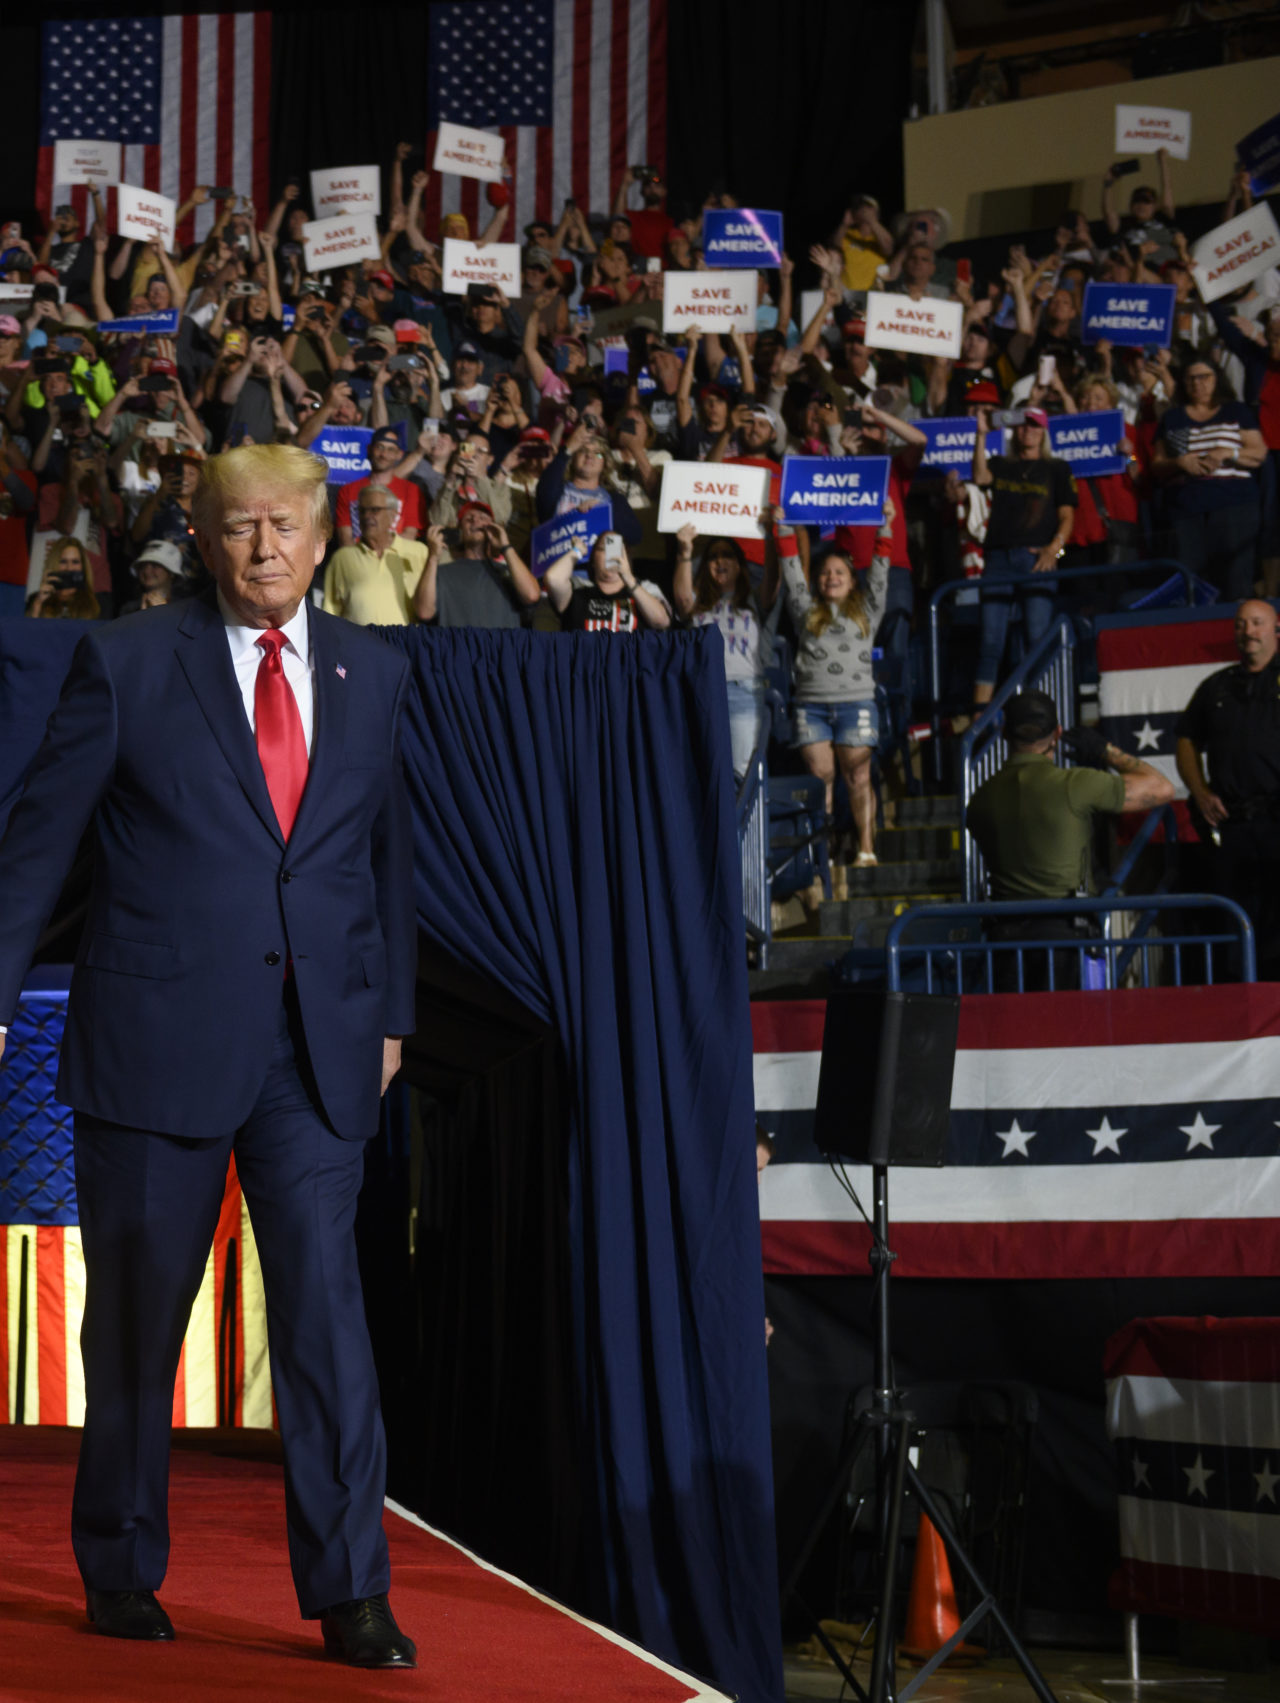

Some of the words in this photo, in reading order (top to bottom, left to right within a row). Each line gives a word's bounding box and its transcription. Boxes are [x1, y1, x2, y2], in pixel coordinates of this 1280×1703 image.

[1139, 118, 1170, 128] SAVE
[1124, 131, 1184, 144] AMERICA!
[458, 139, 487, 153] SAVE
[442, 151, 497, 169] AMERICA!
[329, 179, 360, 191] SAVE
[320, 192, 372, 205] AMERICA!
[137, 202, 162, 217] SAVE
[324, 227, 356, 241] SAVE
[725, 223, 763, 236] SAVE
[313, 236, 371, 256] AMERICA!
[708, 239, 777, 252] AMERICA!
[1214, 230, 1254, 259] SAVE
[464, 256, 497, 268] SAVE
[1206, 236, 1277, 282] AMERICA!
[451, 269, 513, 282] AMERICA!
[691, 288, 731, 299] SAVE
[673, 305, 748, 316] AMERICA!
[1107, 299, 1148, 312] SAVE
[896, 309, 934, 323] SAVE
[1088, 316, 1165, 331] AMERICA!
[876, 322, 952, 341] AMERICA!
[1057, 428, 1098, 444] SAVE
[322, 440, 360, 454] SAVE
[813, 473, 860, 488] SAVE
[694, 481, 739, 496] SAVE
[790, 492, 878, 507] AMERICA!
[671, 500, 758, 517] AMERICA!
[550, 520, 587, 542] SAVE
